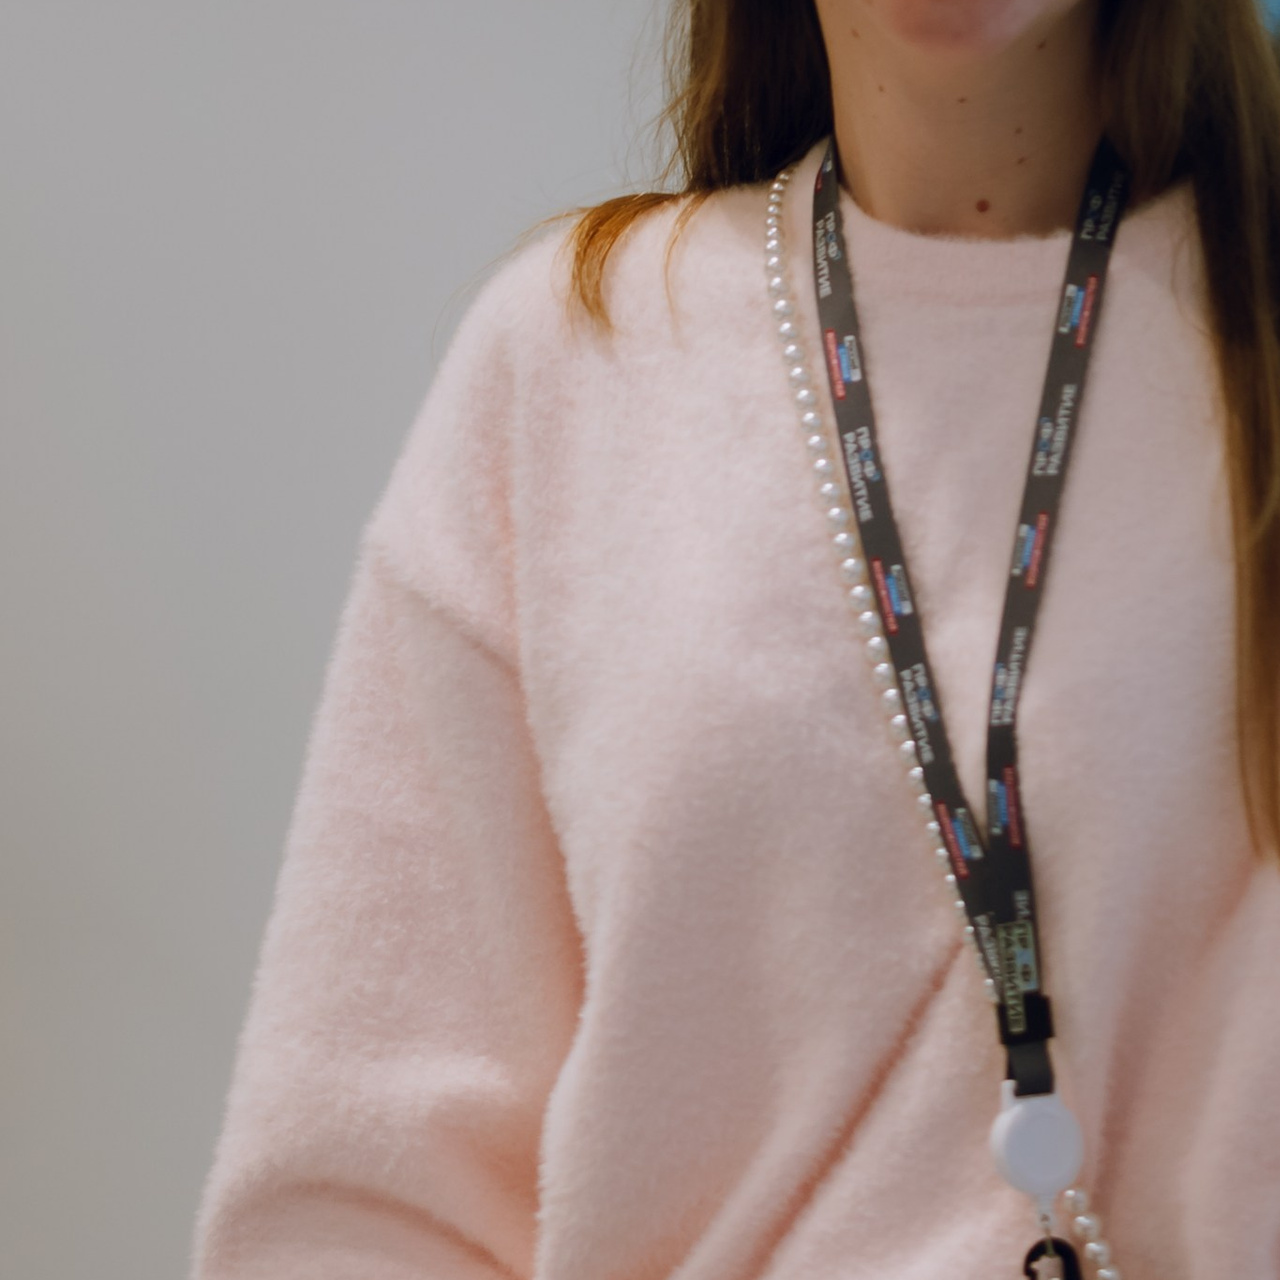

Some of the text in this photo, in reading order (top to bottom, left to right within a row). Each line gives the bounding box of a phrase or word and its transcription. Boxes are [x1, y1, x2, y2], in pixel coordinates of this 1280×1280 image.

[815, 219, 832, 299] РАЗВИТИЕ
[1046, 384, 1077, 475] РАЗВИТИЕ
[843, 432, 874, 522] РАЗВИТИЕ
[900, 669, 935, 764] РАЗВИТИЕ
[1002, 626, 1028, 724] РАЗВИТИЕ
[1003, 925, 1025, 1032] РАЗВИТИЕ
